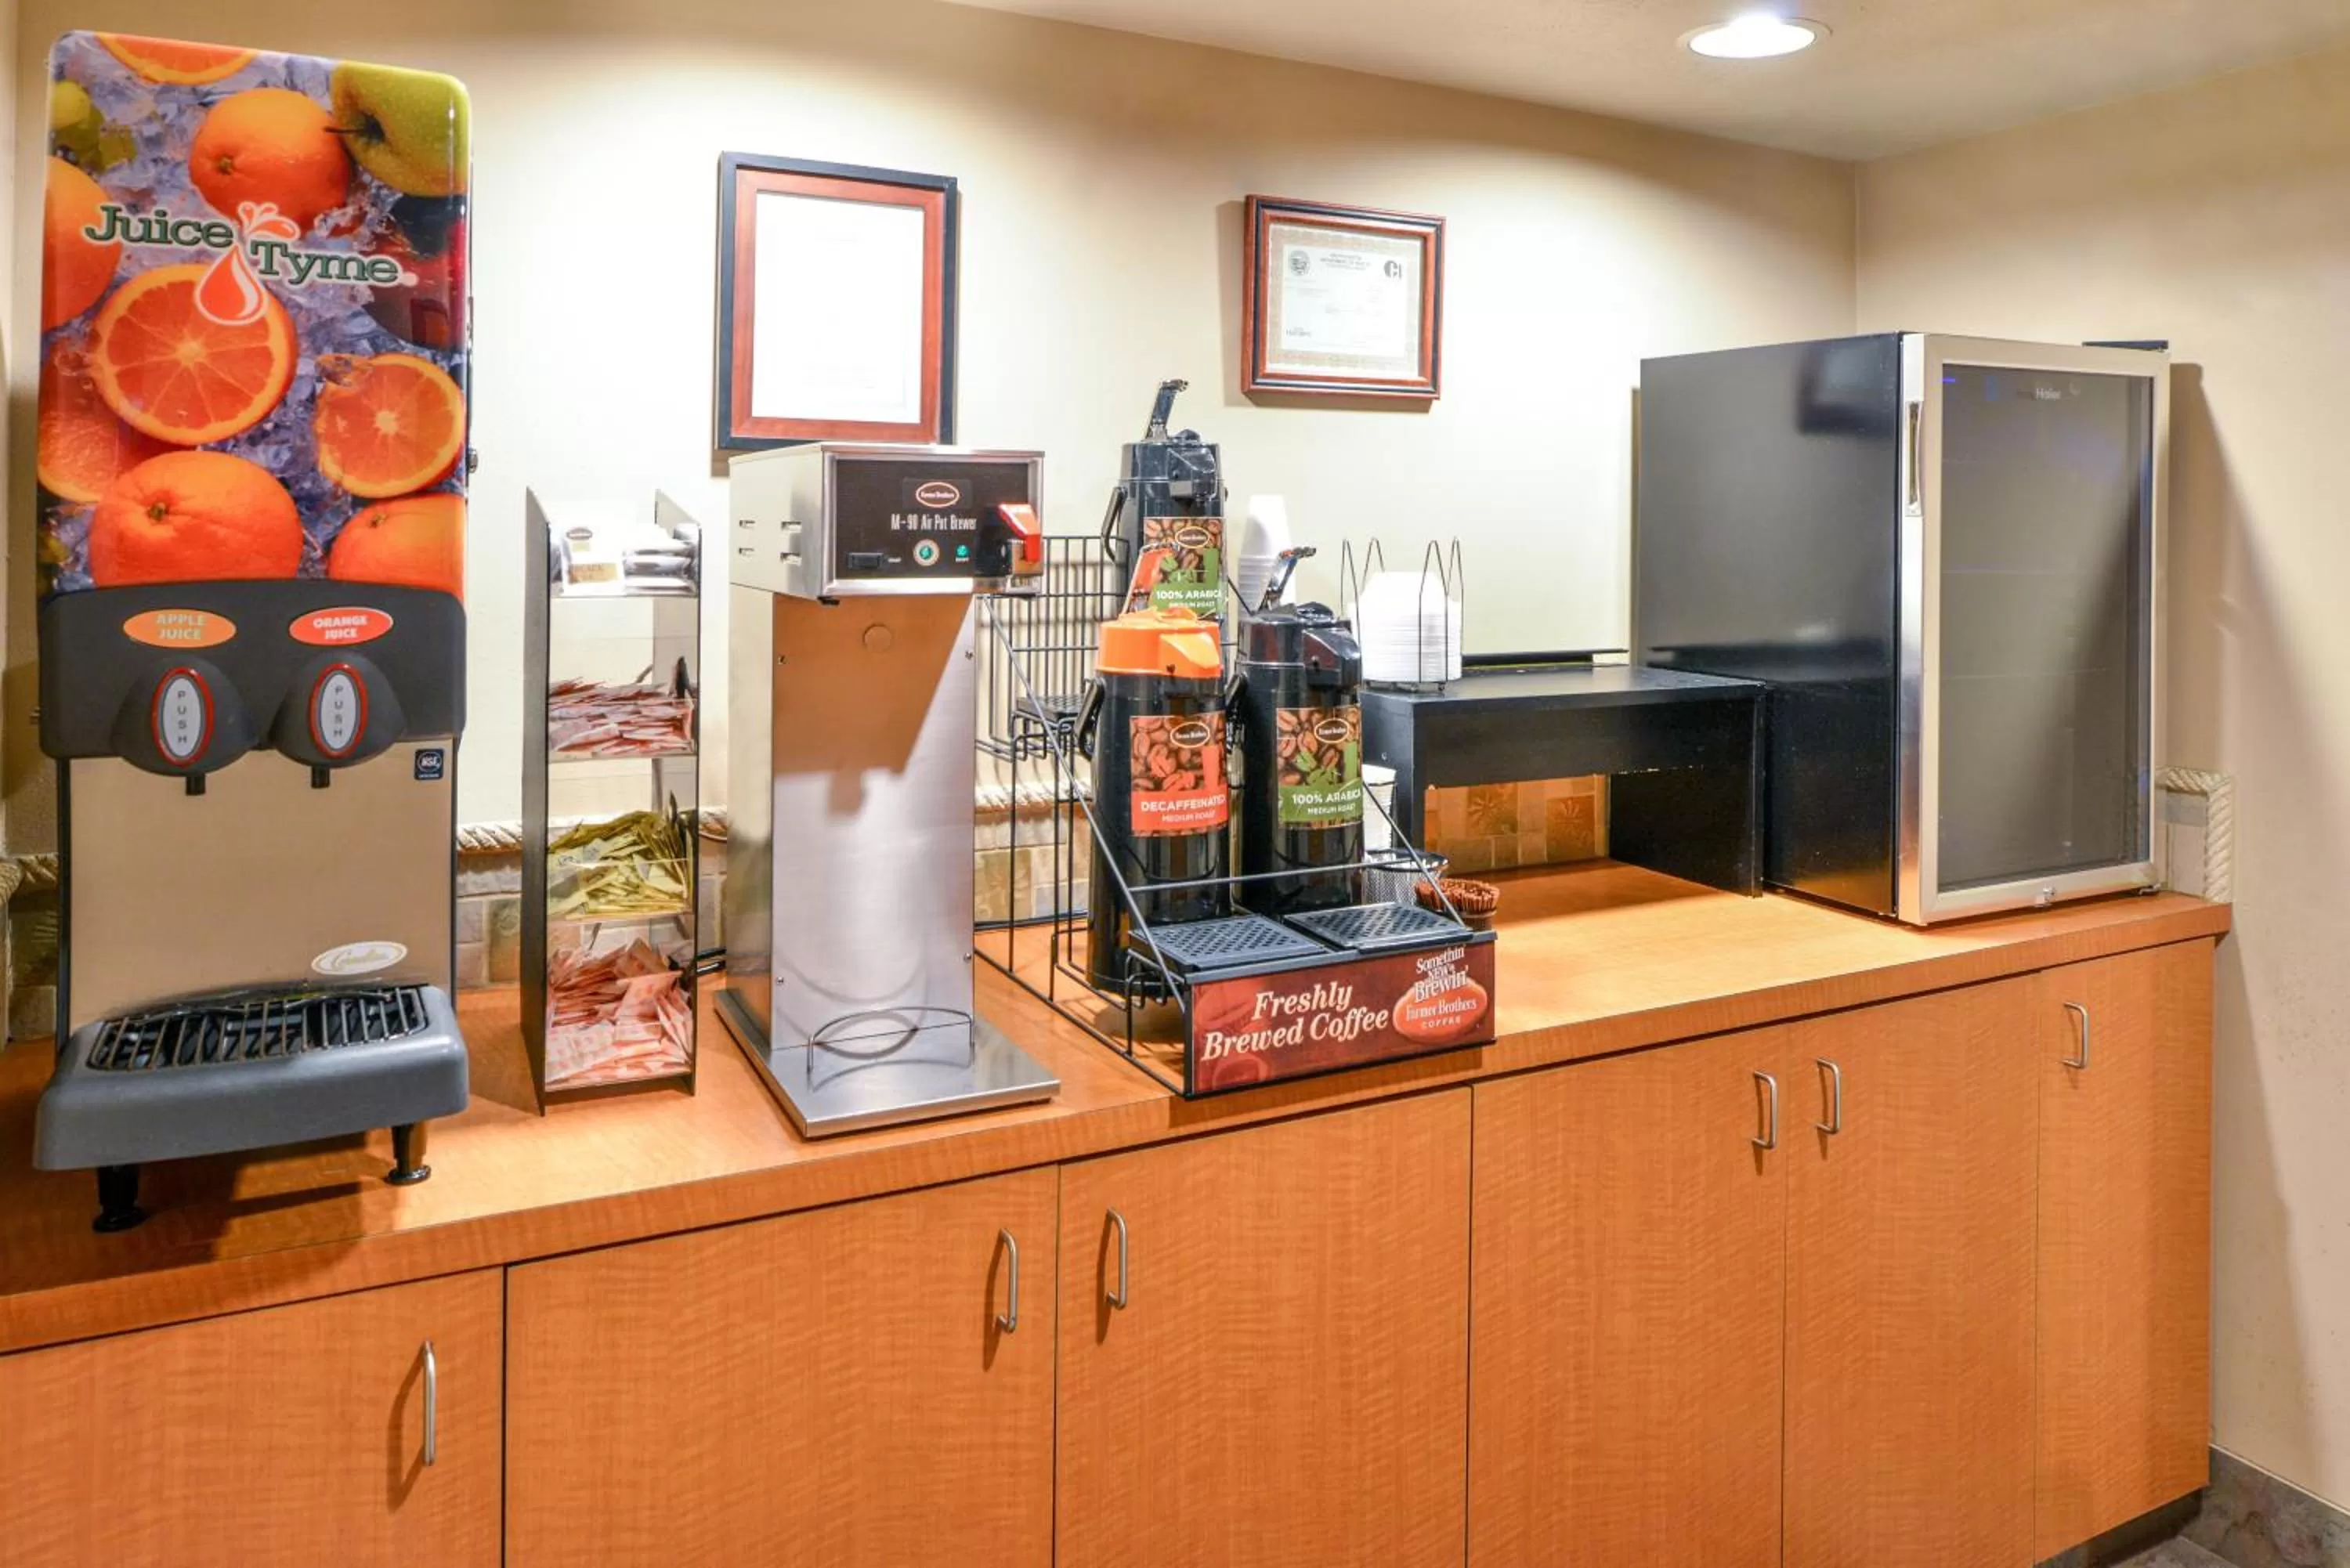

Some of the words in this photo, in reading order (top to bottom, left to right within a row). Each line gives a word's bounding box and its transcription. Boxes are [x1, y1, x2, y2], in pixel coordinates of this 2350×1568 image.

[85, 204, 233, 248] Juice
[250, 240, 398, 285] Tyme
[920, 513, 932, 530] Air
[935, 513, 947, 530] Pot
[950, 514, 977, 530] Brewer
[1156, 590, 1183, 600] 100%
[156, 613, 207, 627] APPLE
[313, 616, 367, 629] ORANGE
[159, 629, 201, 640] JUICE
[325, 628, 358, 640] JUICE
[177, 690, 187, 744] PUSH
[334, 685, 344, 737] PUSH
[1292, 792, 1323, 804] 100%
[1251, 981, 1354, 1021] Freshly
[1422, 1016, 1461, 1028] COFFEE
[1200, 1017, 1305, 1062] Brewed
[1309, 1006, 1389, 1042] Coffee
